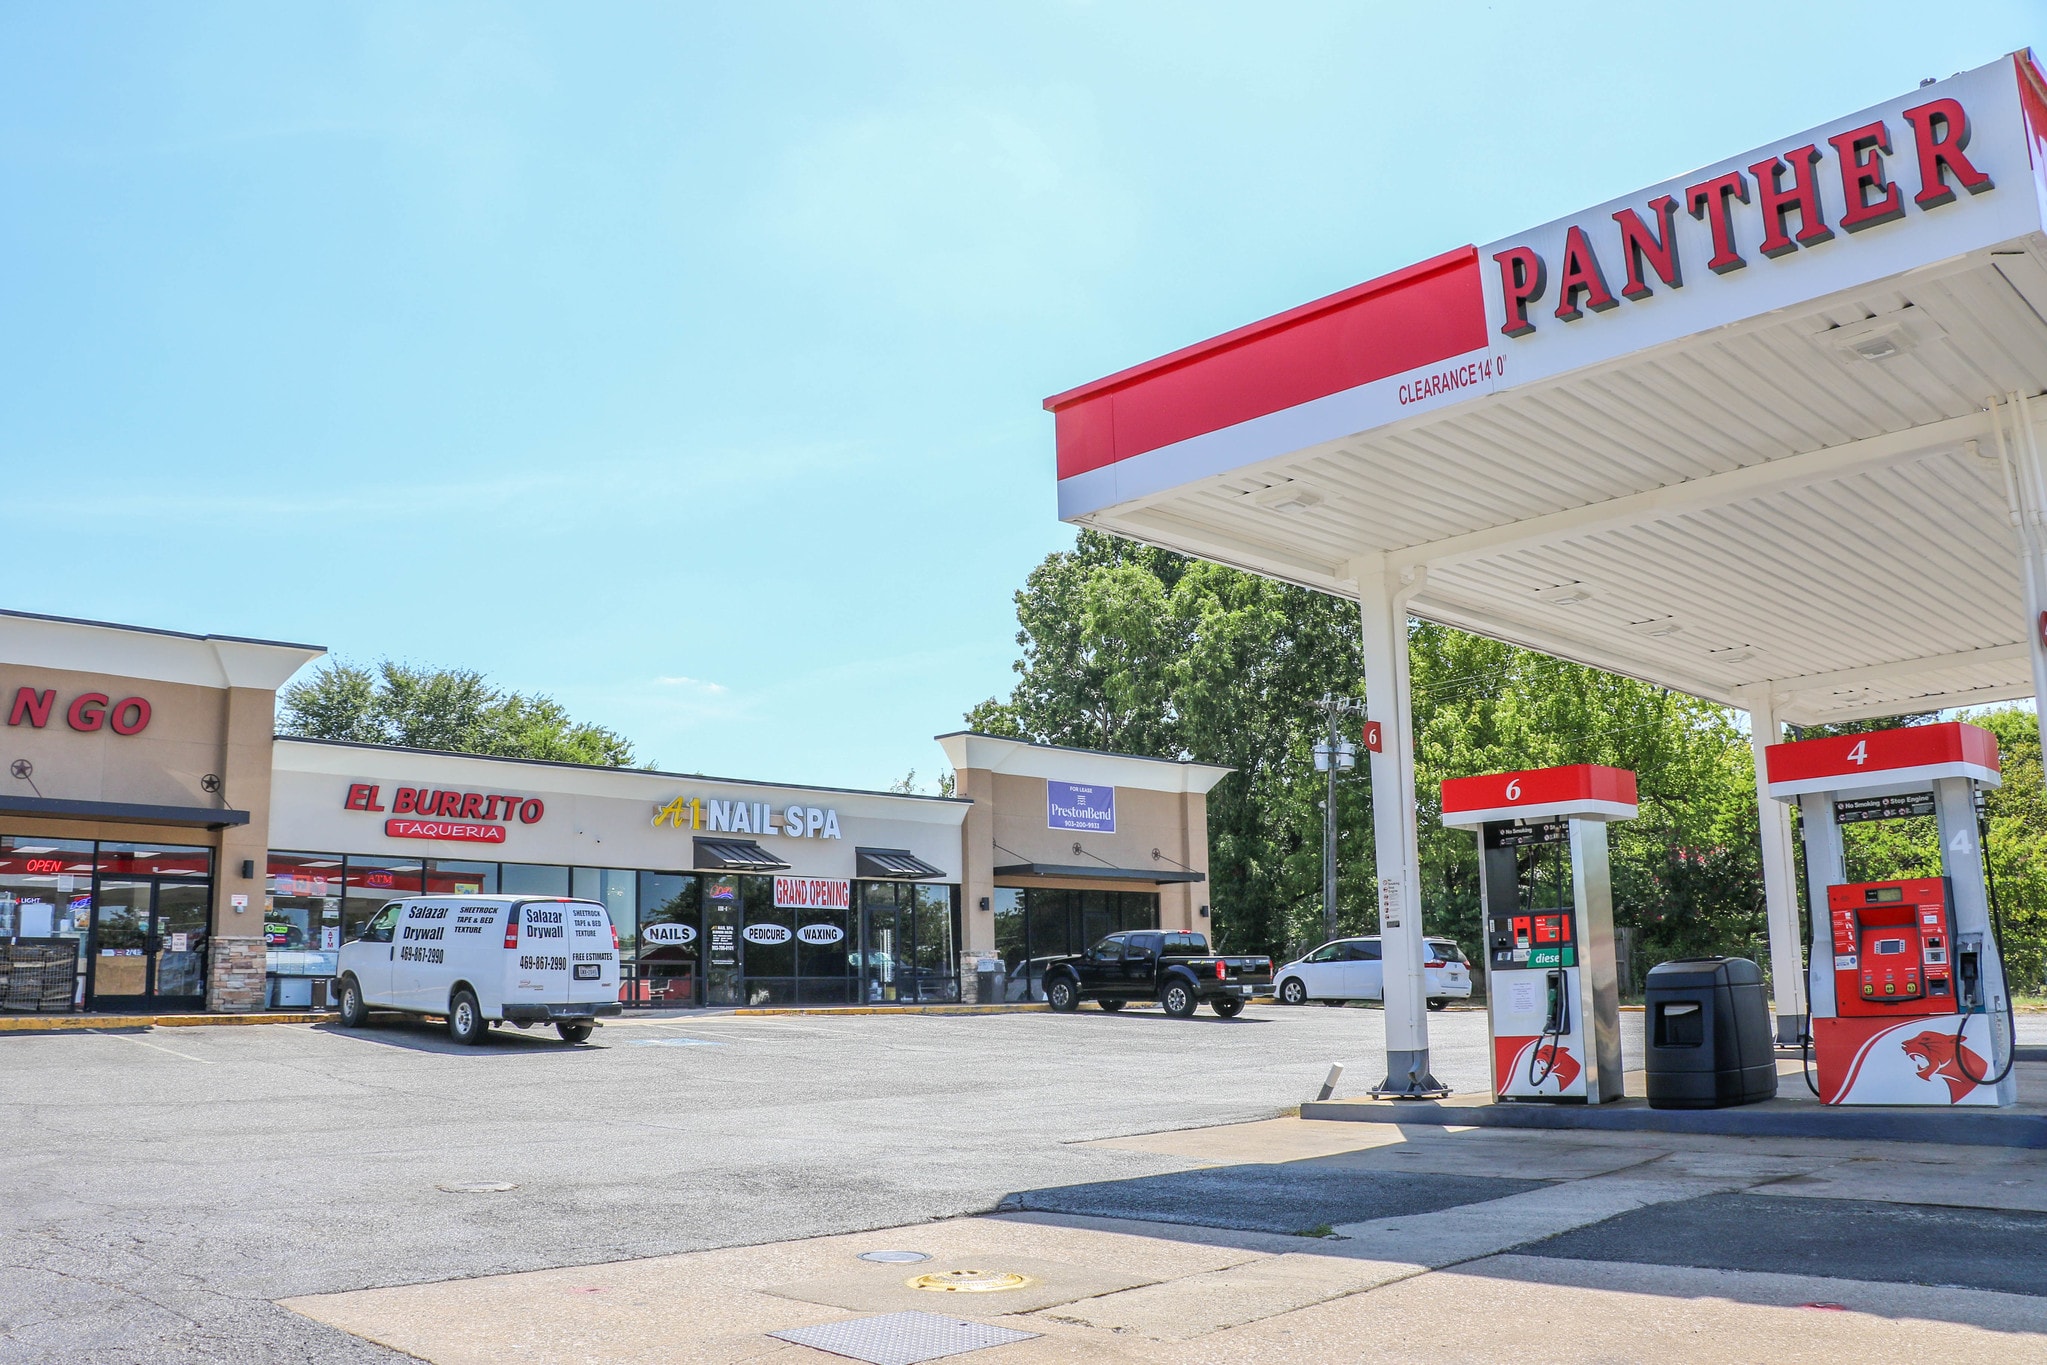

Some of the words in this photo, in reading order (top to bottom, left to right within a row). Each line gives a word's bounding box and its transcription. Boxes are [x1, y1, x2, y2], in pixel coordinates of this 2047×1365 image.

[1492, 98, 1994, 338] PANTHER
[1399, 364, 1477, 405] CLEARANCE
[8, 687, 57, 728] N
[67, 693, 152, 735] GO
[1369, 728, 1377, 745] 6
[1847, 740, 1868, 765] 4
[1505, 779, 1521, 801] 6
[345, 784, 385, 812] EL
[392, 787, 544, 824] BURRITO
[1051, 803, 1111, 821] PrestonBend
[652, 796, 701, 831] A1
[707, 799, 778, 835] NAIL
[785, 805, 842, 839] SPA
[394, 822, 500, 839] TAQUERIA
[1949, 829, 1972, 855] 4
[27, 859, 62, 872] OPEN
[367, 874, 393, 884] ATM
[777, 879, 807, 905] GRAND
[810, 880, 848, 906] OPENING
[409, 906, 449, 919] Salazar
[459, 906, 499, 914] SHEETROCK
[526, 908, 562, 924] Salazar
[572, 909, 601, 917] SHEETROCK
[457, 916, 471, 924] TAPE
[403, 926, 445, 940] Drywall
[454, 926, 482, 934] TEXTURE
[527, 925, 563, 939] Drywall
[649, 928, 690, 941] NAILS
[749, 929, 786, 941] PEDICURE
[804, 929, 837, 941] WAXING
[400, 946, 444, 964] 469-867-2990
[1967, 943, 1973, 952] 4
[519, 955, 567, 971] 469-867-2990
[572, 953, 585, 961] FREE
[586, 953, 613, 961] ESTIMATES
